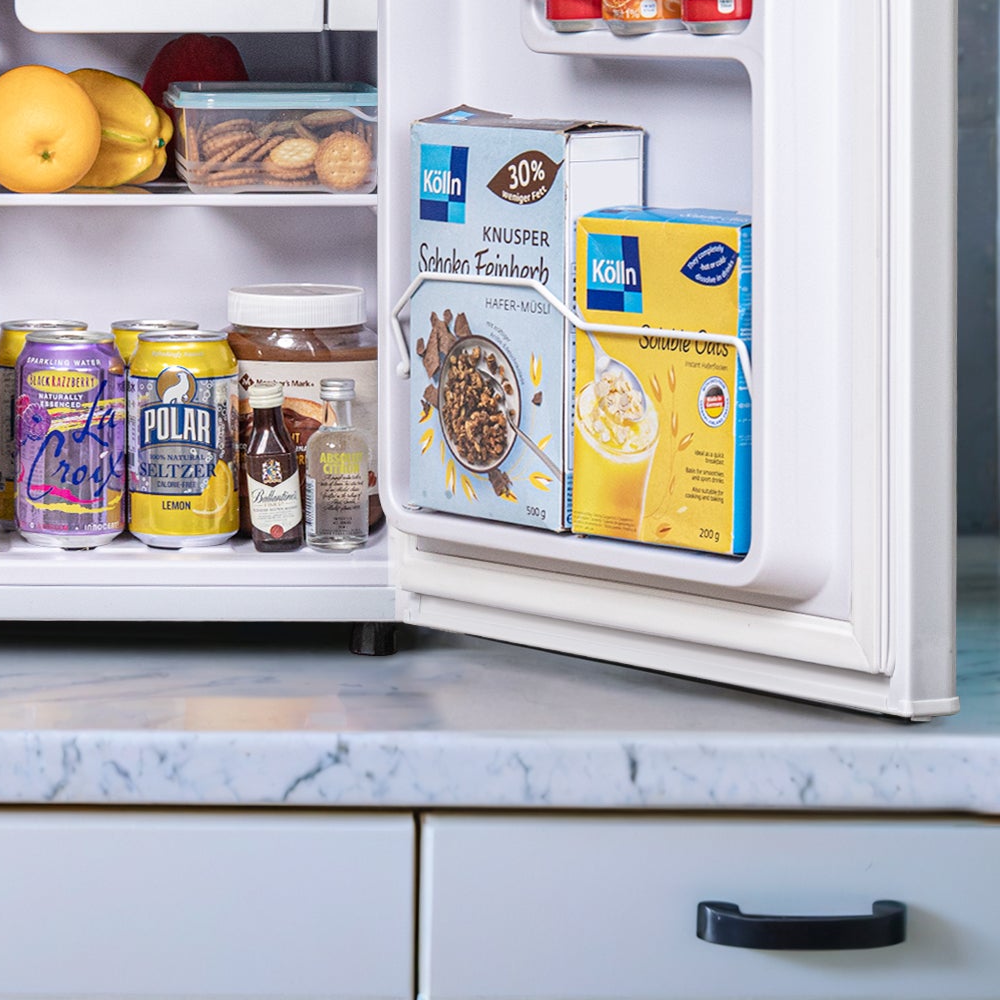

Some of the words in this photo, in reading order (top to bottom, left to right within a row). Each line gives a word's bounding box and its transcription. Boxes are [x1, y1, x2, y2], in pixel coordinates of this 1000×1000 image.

[423, 169, 462, 196] Kölln
[508, 159, 546, 190] 30%
[501, 190, 531, 205] weniger
[531, 185, 548, 200] Fett
[483, 226, 550, 247] KNUSPER
[592, 258, 637, 286] Kölln
[26, 356, 70, 366] SPARKLING
[144, 406, 211, 444] POLAR
[319, 452, 363, 464] ABSOLUT
[139, 463, 216, 478] SELTZER
[323, 463, 360, 475] CITRON
[161, 501, 191, 511] LEMON
[526, 505, 540, 516] 500
[541, 509, 546, 520] g
[699, 527, 714, 539] 200
[714, 532, 720, 543] g
